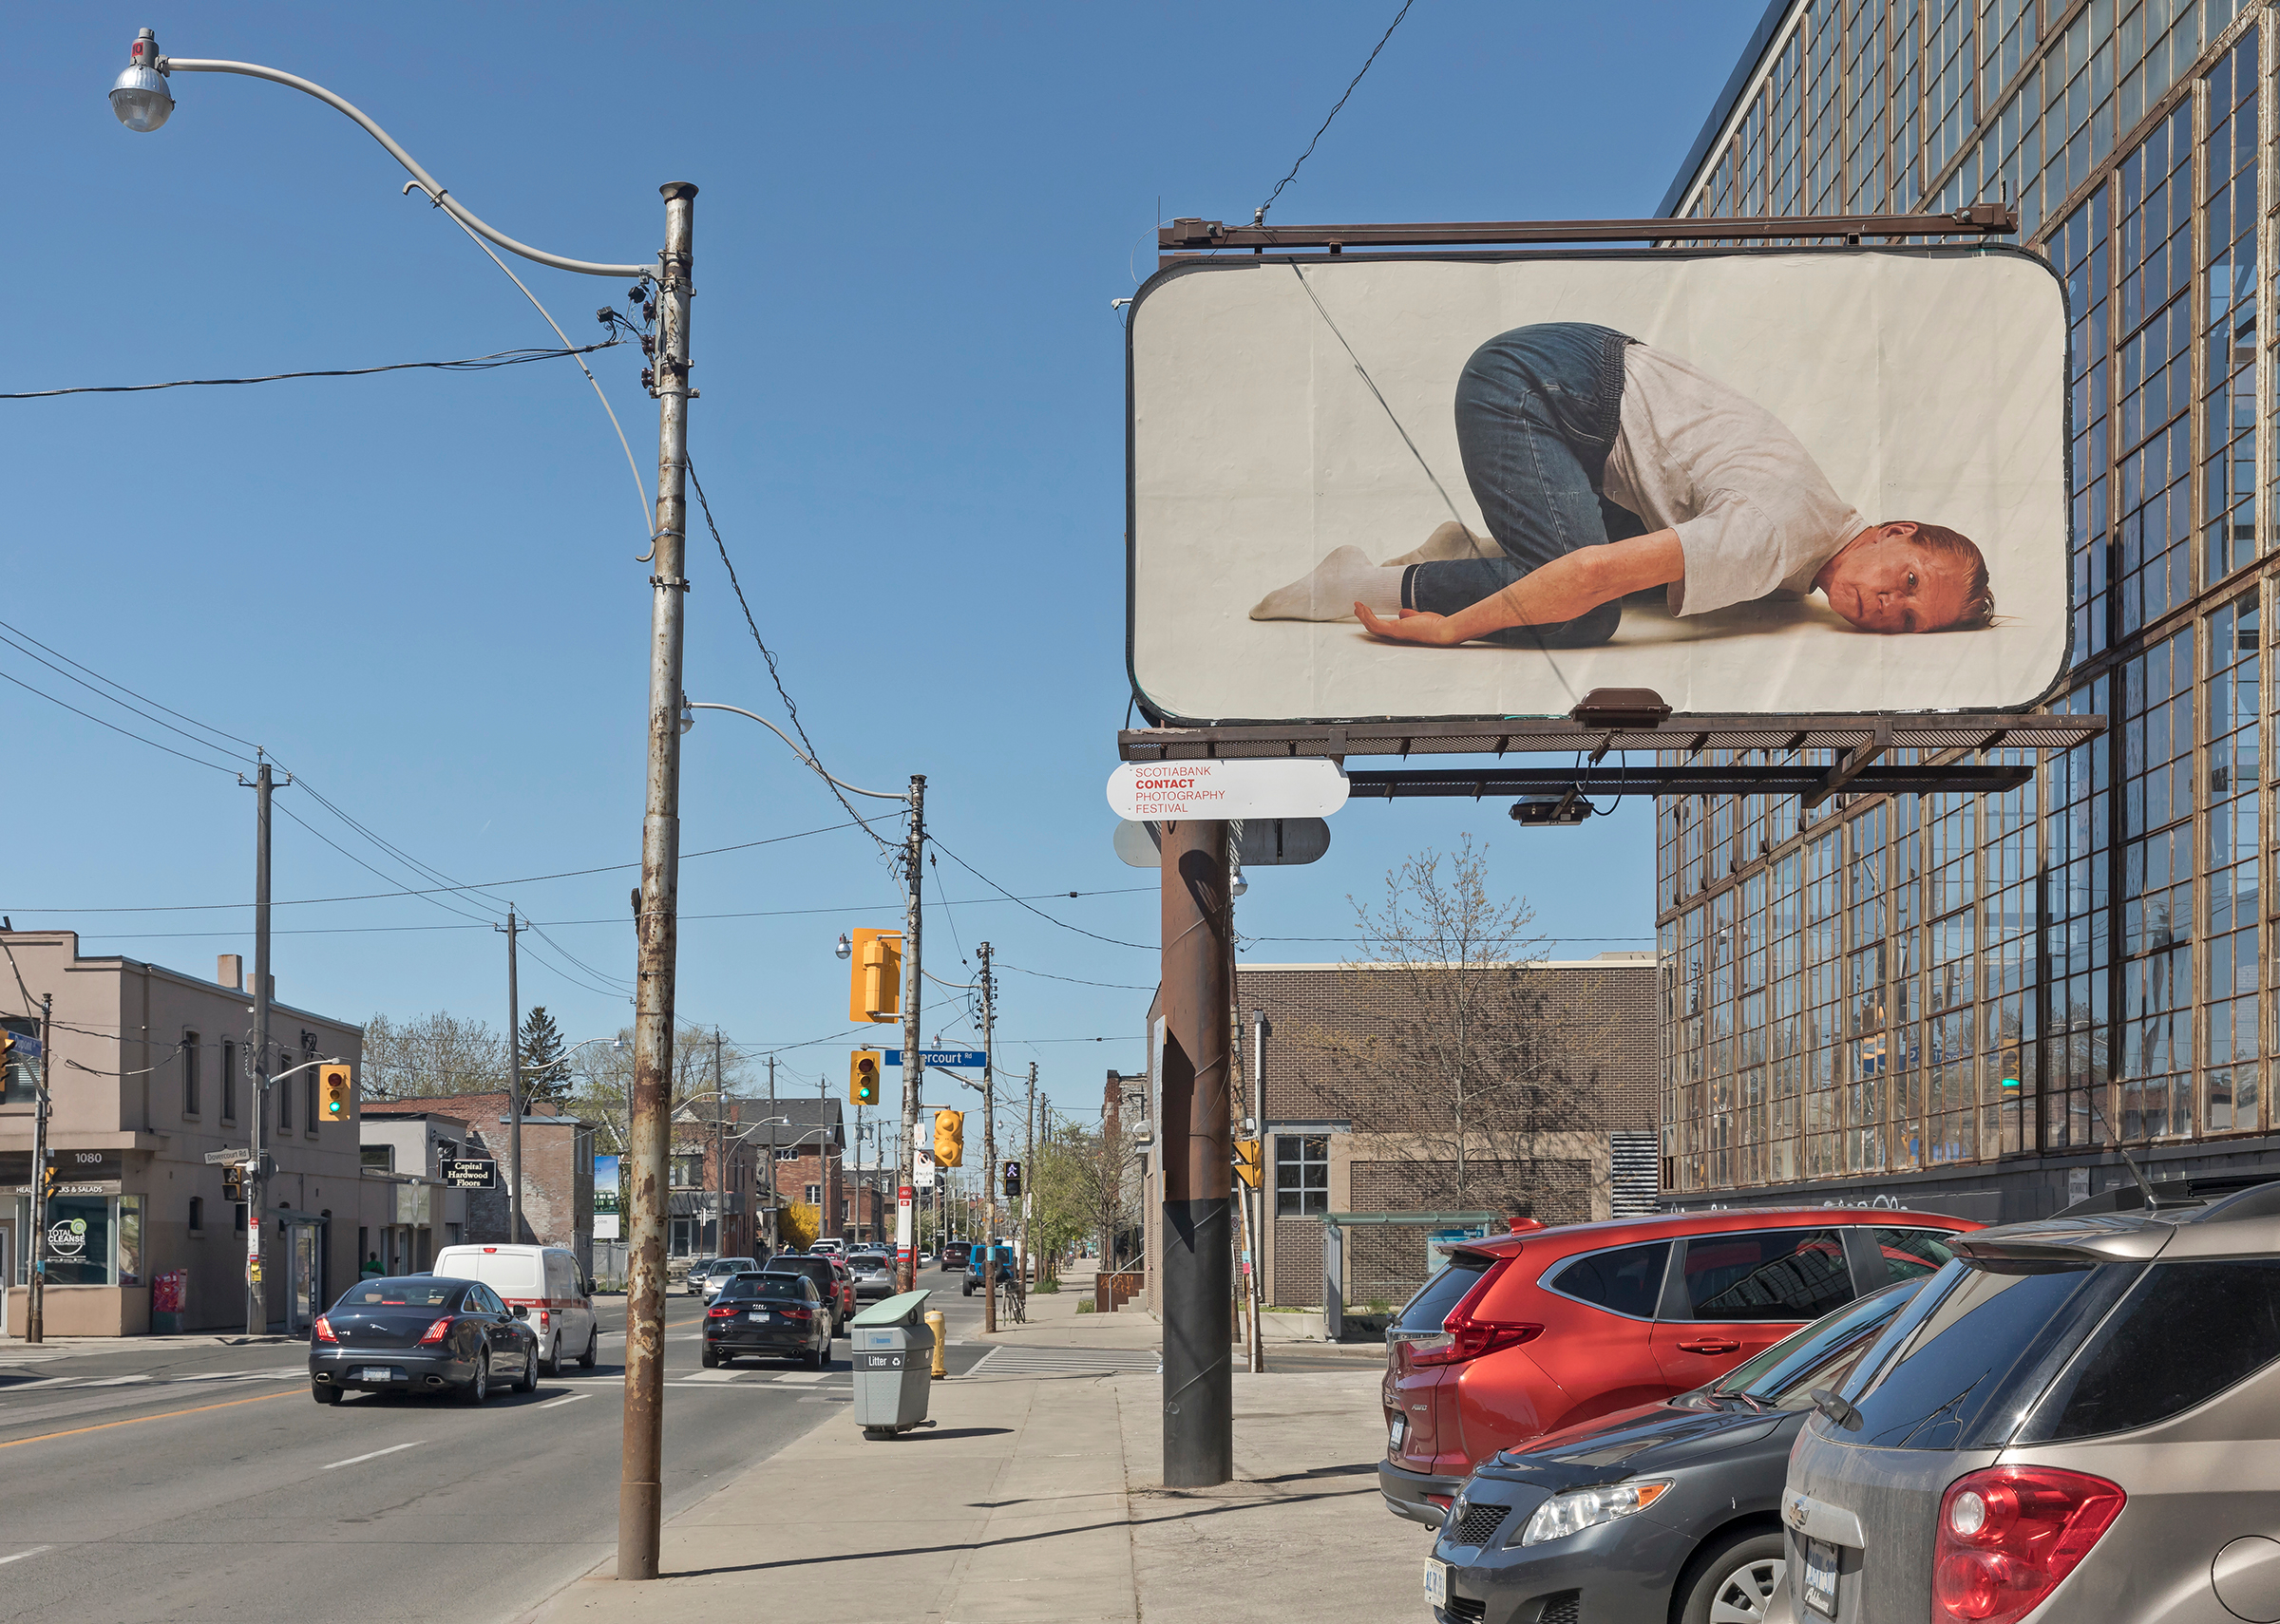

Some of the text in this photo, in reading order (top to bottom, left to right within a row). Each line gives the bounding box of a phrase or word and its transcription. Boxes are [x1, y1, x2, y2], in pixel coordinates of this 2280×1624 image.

[1135, 765, 1211, 778] SCOTIABANK
[1135, 779, 1195, 789] CONTACT
[1135, 790, 1226, 802] PHOTOGRAPHY
[1135, 803, 1188, 814] FESTIVAL
[899, 1051, 961, 1064] Dercourt
[75, 1152, 103, 1163] 1080
[207, 1150, 238, 1161] Dovercourt
[454, 1161, 483, 1171] Capital
[447, 1170, 488, 1180] Hardwood
[868, 1355, 887, 1367] Litter
